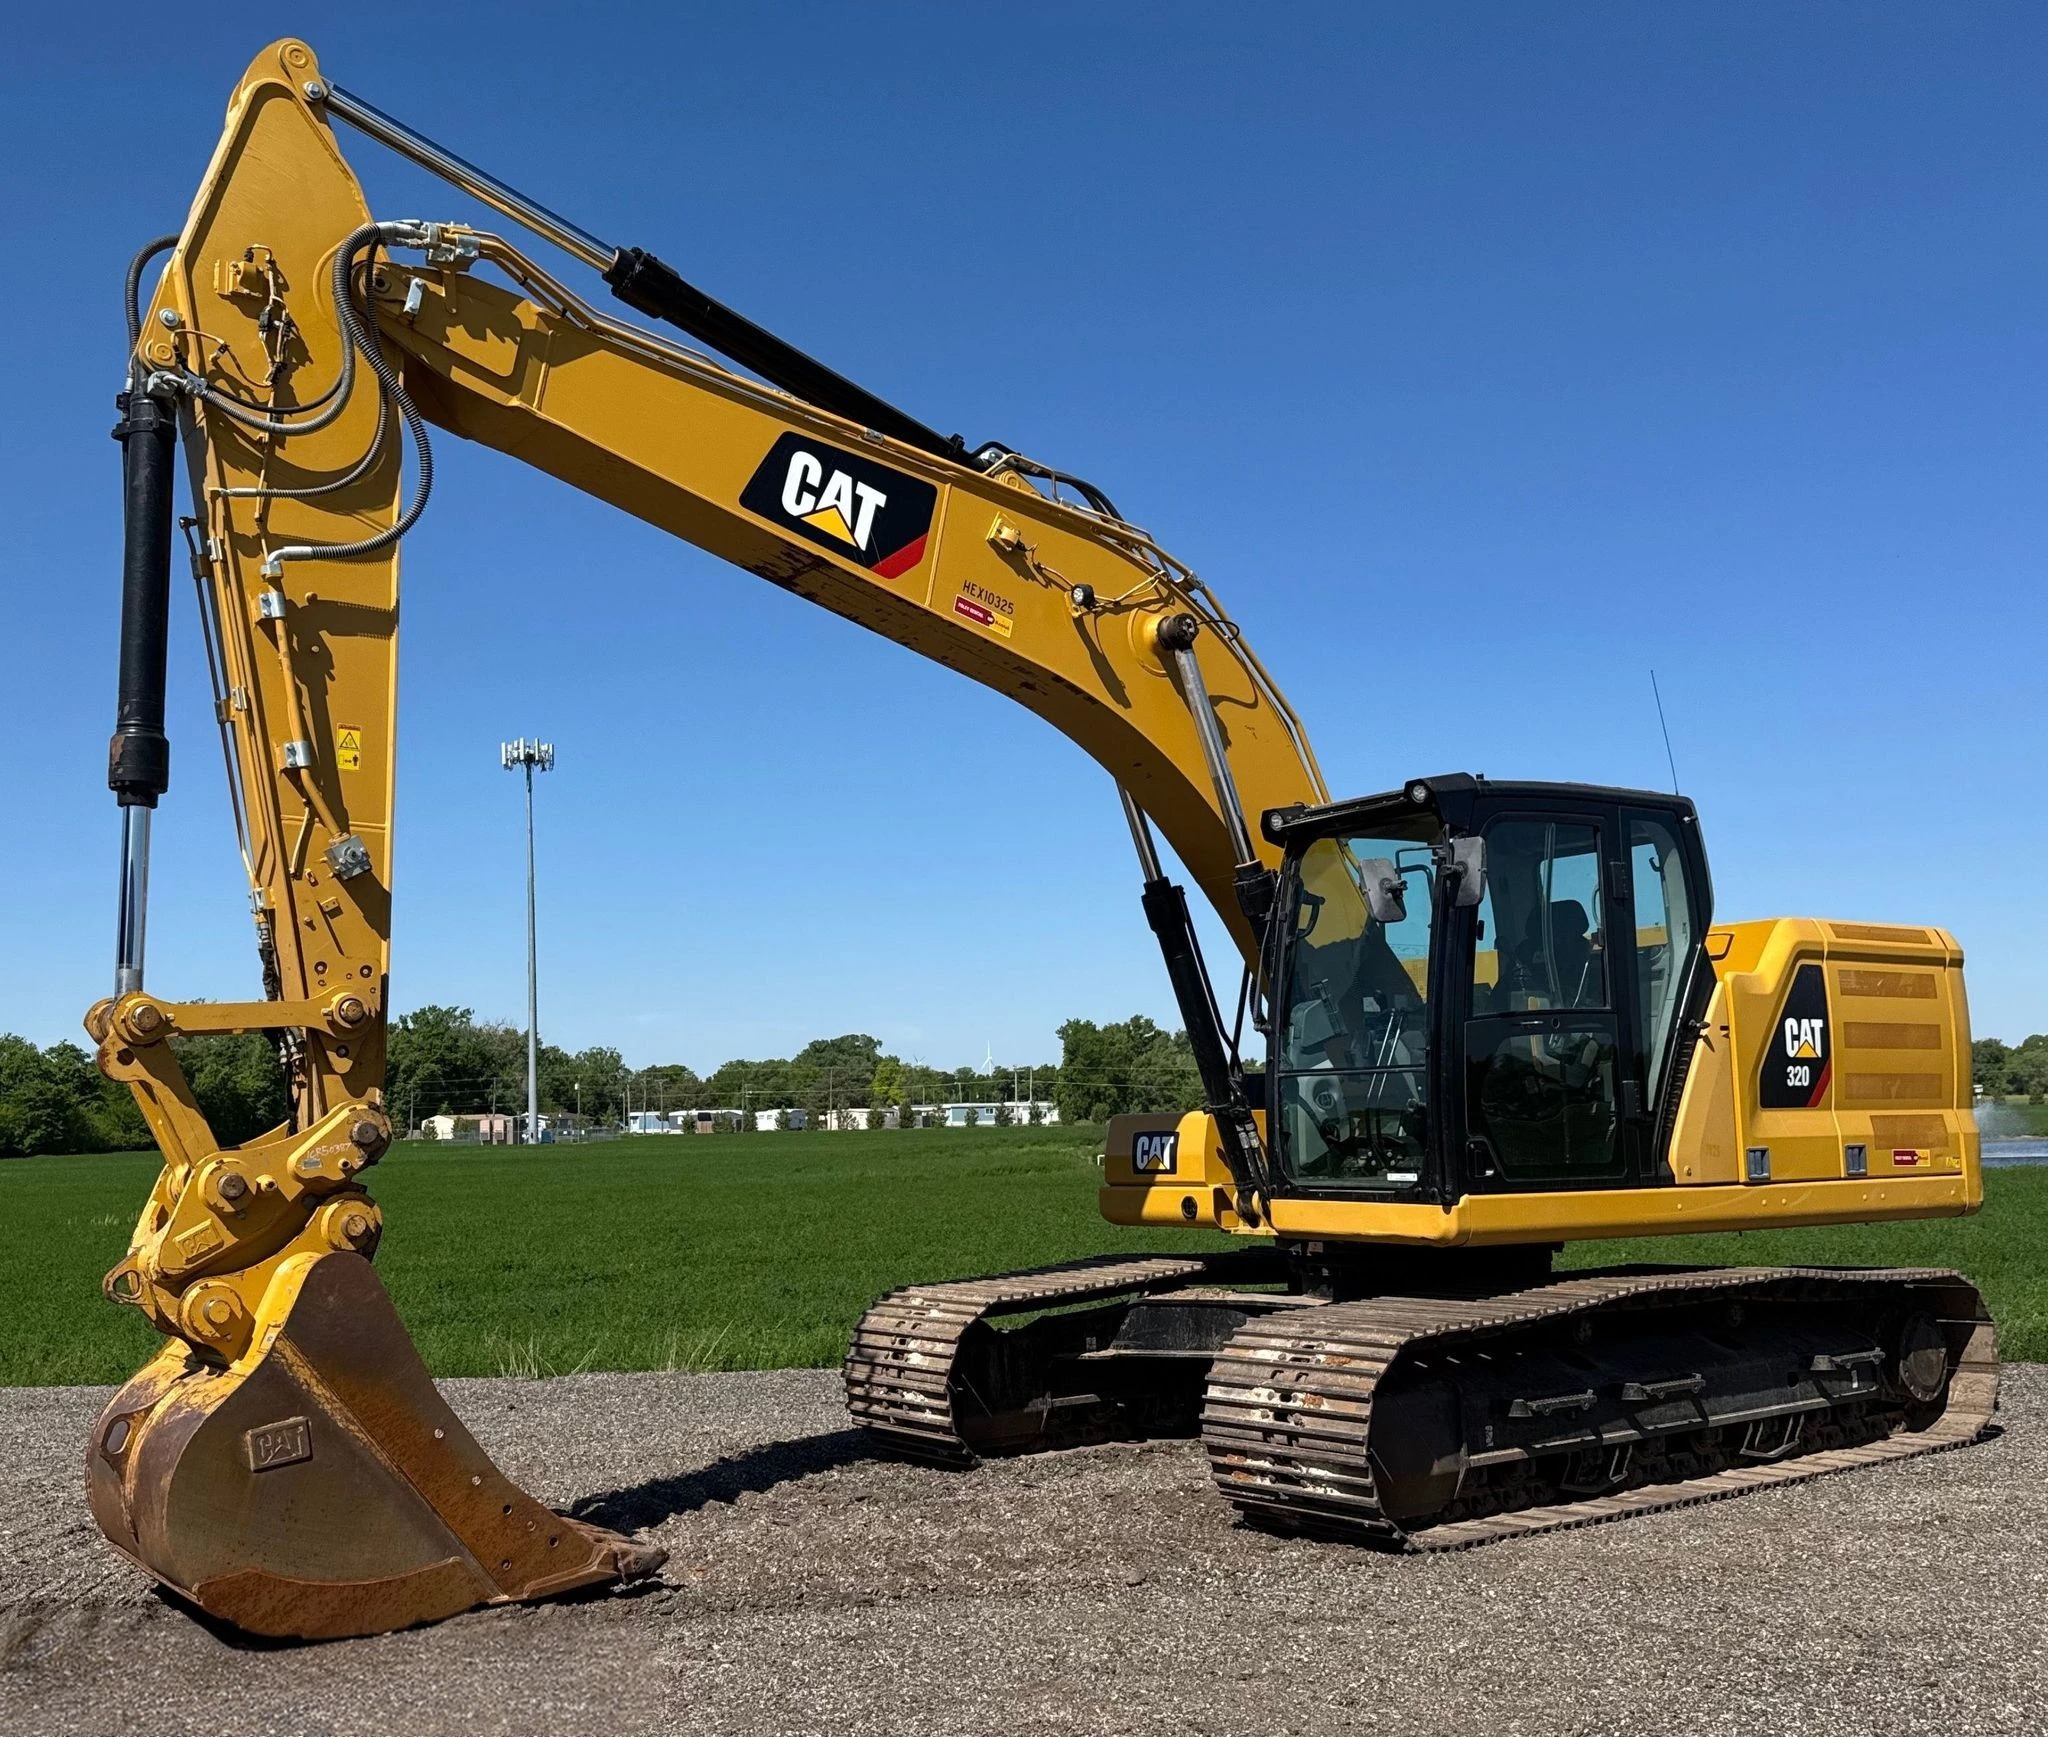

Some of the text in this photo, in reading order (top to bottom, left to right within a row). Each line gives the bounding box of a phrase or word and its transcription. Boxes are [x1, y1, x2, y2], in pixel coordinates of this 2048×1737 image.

[781, 450, 888, 552] CAT
[962, 579, 1014, 615] HEX10325
[1784, 1017, 1824, 1058] CAT
[1786, 1065, 1810, 1087] 320
[1136, 1135, 1175, 1170] CAT
[254, 1424, 304, 1465] CAT
